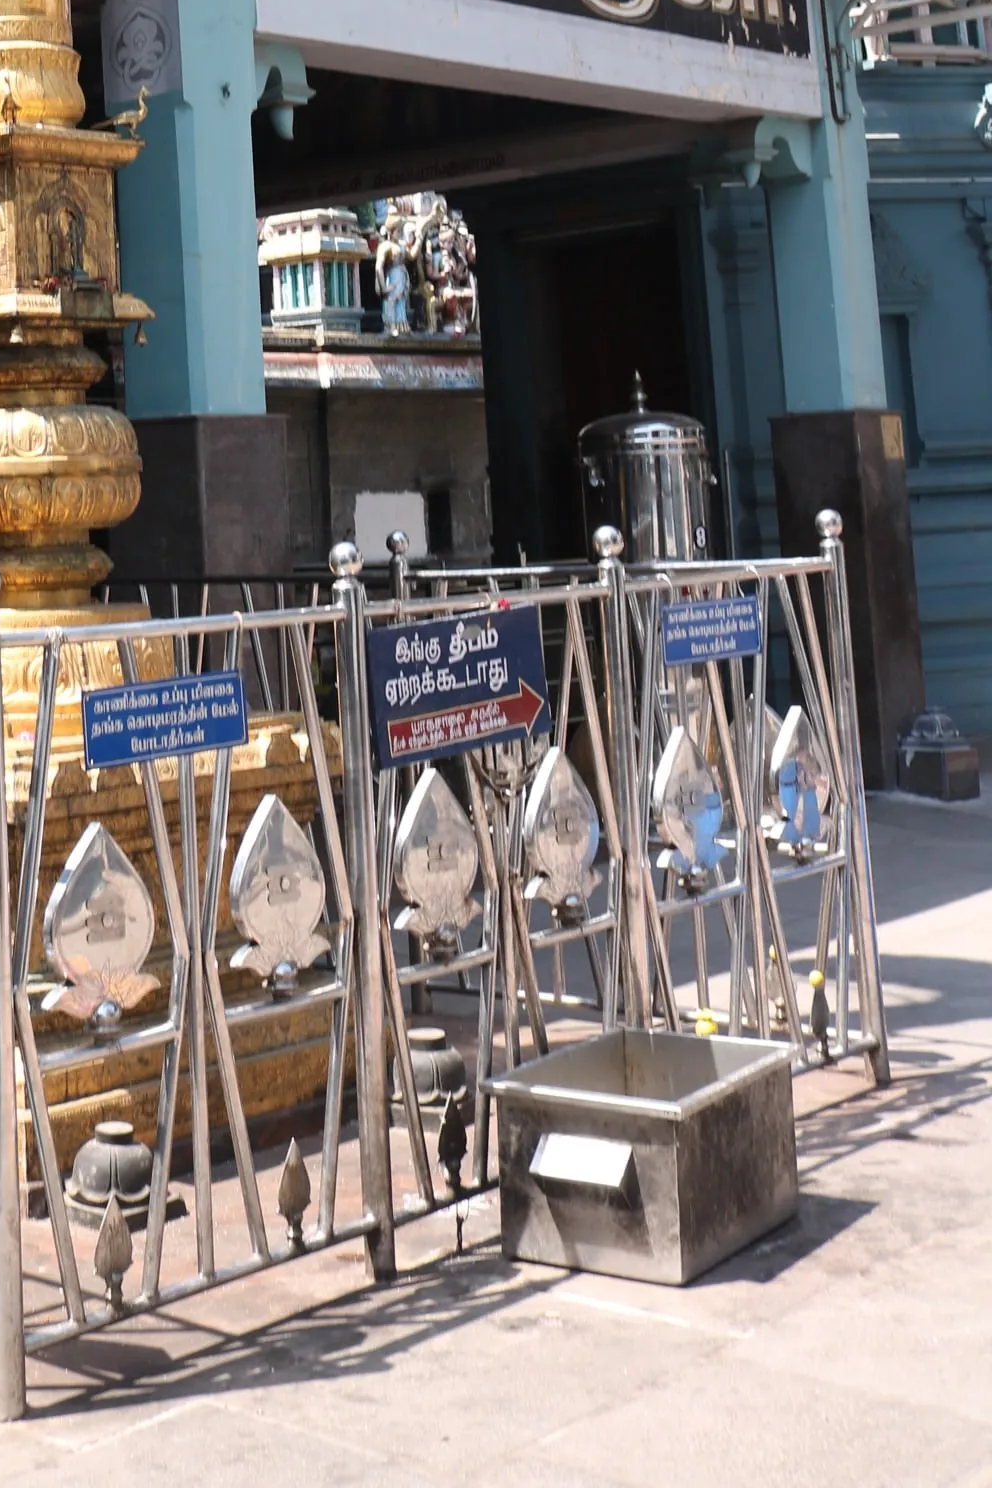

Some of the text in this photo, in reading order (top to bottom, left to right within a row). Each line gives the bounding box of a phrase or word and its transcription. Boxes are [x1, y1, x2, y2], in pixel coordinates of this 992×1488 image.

[395, 620, 499, 665] இங்கு தீபம்
[93, 691, 159, 715] காணிக்கை
[161, 684, 188, 705] உப்பு
[385, 656, 508, 707] ஏற்றக்கூடாது
[91, 697, 239, 740] தங்க கொடிமரத்தின் மேல்
[130, 724, 205, 754] போடாதீர்கள்
